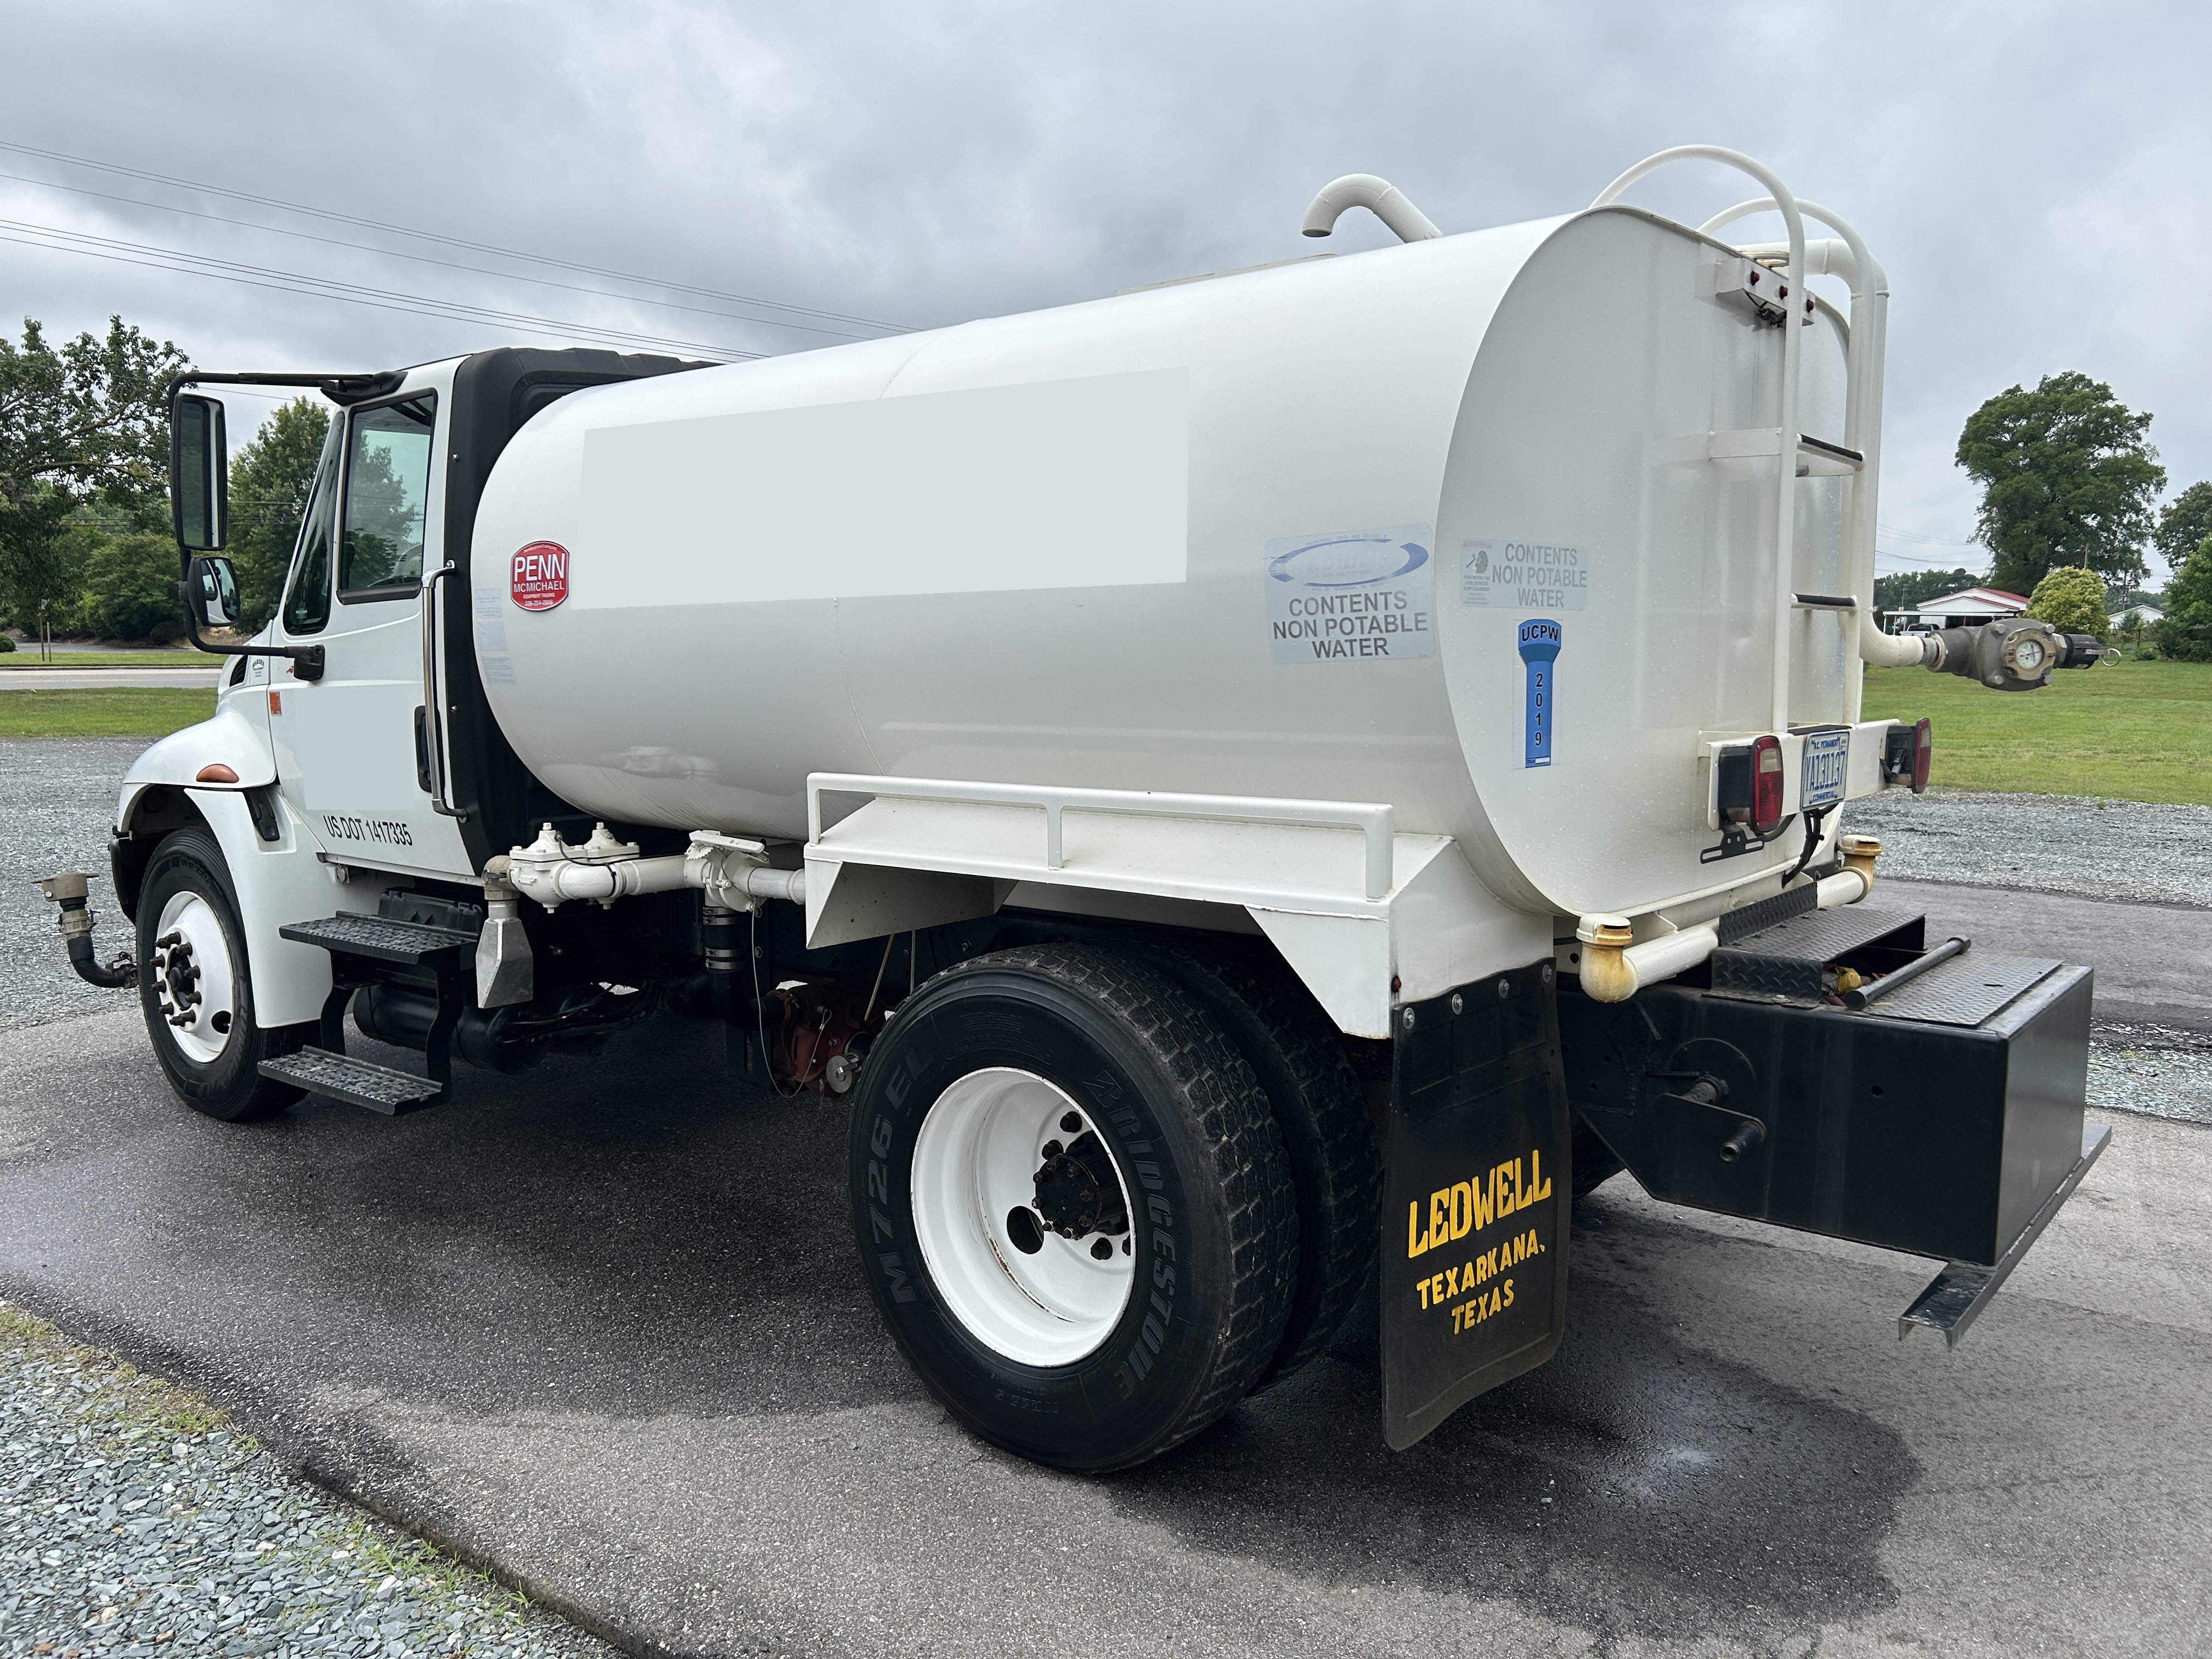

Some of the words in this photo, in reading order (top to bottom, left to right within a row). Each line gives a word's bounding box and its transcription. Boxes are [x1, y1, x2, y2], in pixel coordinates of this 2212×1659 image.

[515, 553, 565, 582] PENN
[1505, 543, 1577, 566] CONTENTS
[514, 581, 565, 592] MCMICHAEL
[1492, 565, 1522, 584] NON
[1527, 567, 1587, 588] POTABLE
[1289, 590, 1407, 617] CONTENTS
[1517, 588, 1564, 607] WATER
[1273, 619, 1318, 640] NON
[1325, 612, 1428, 636] POTABLE
[1521, 624, 1559, 642] UCPW
[1312, 637, 1390, 658] WATER
[323, 815, 343, 838] US
[340, 817, 366, 840] DOT
[366, 820, 413, 846] 1417335
[885, 1047, 933, 1110] EL
[868, 1114, 893, 1244] 726
[1408, 1149, 1551, 1259] LEDWELL
[1082, 1070, 1176, 1401] BRIDGESTONE
[879, 1252, 917, 1304] M
[1452, 1279, 1514, 1334] TEXAS
